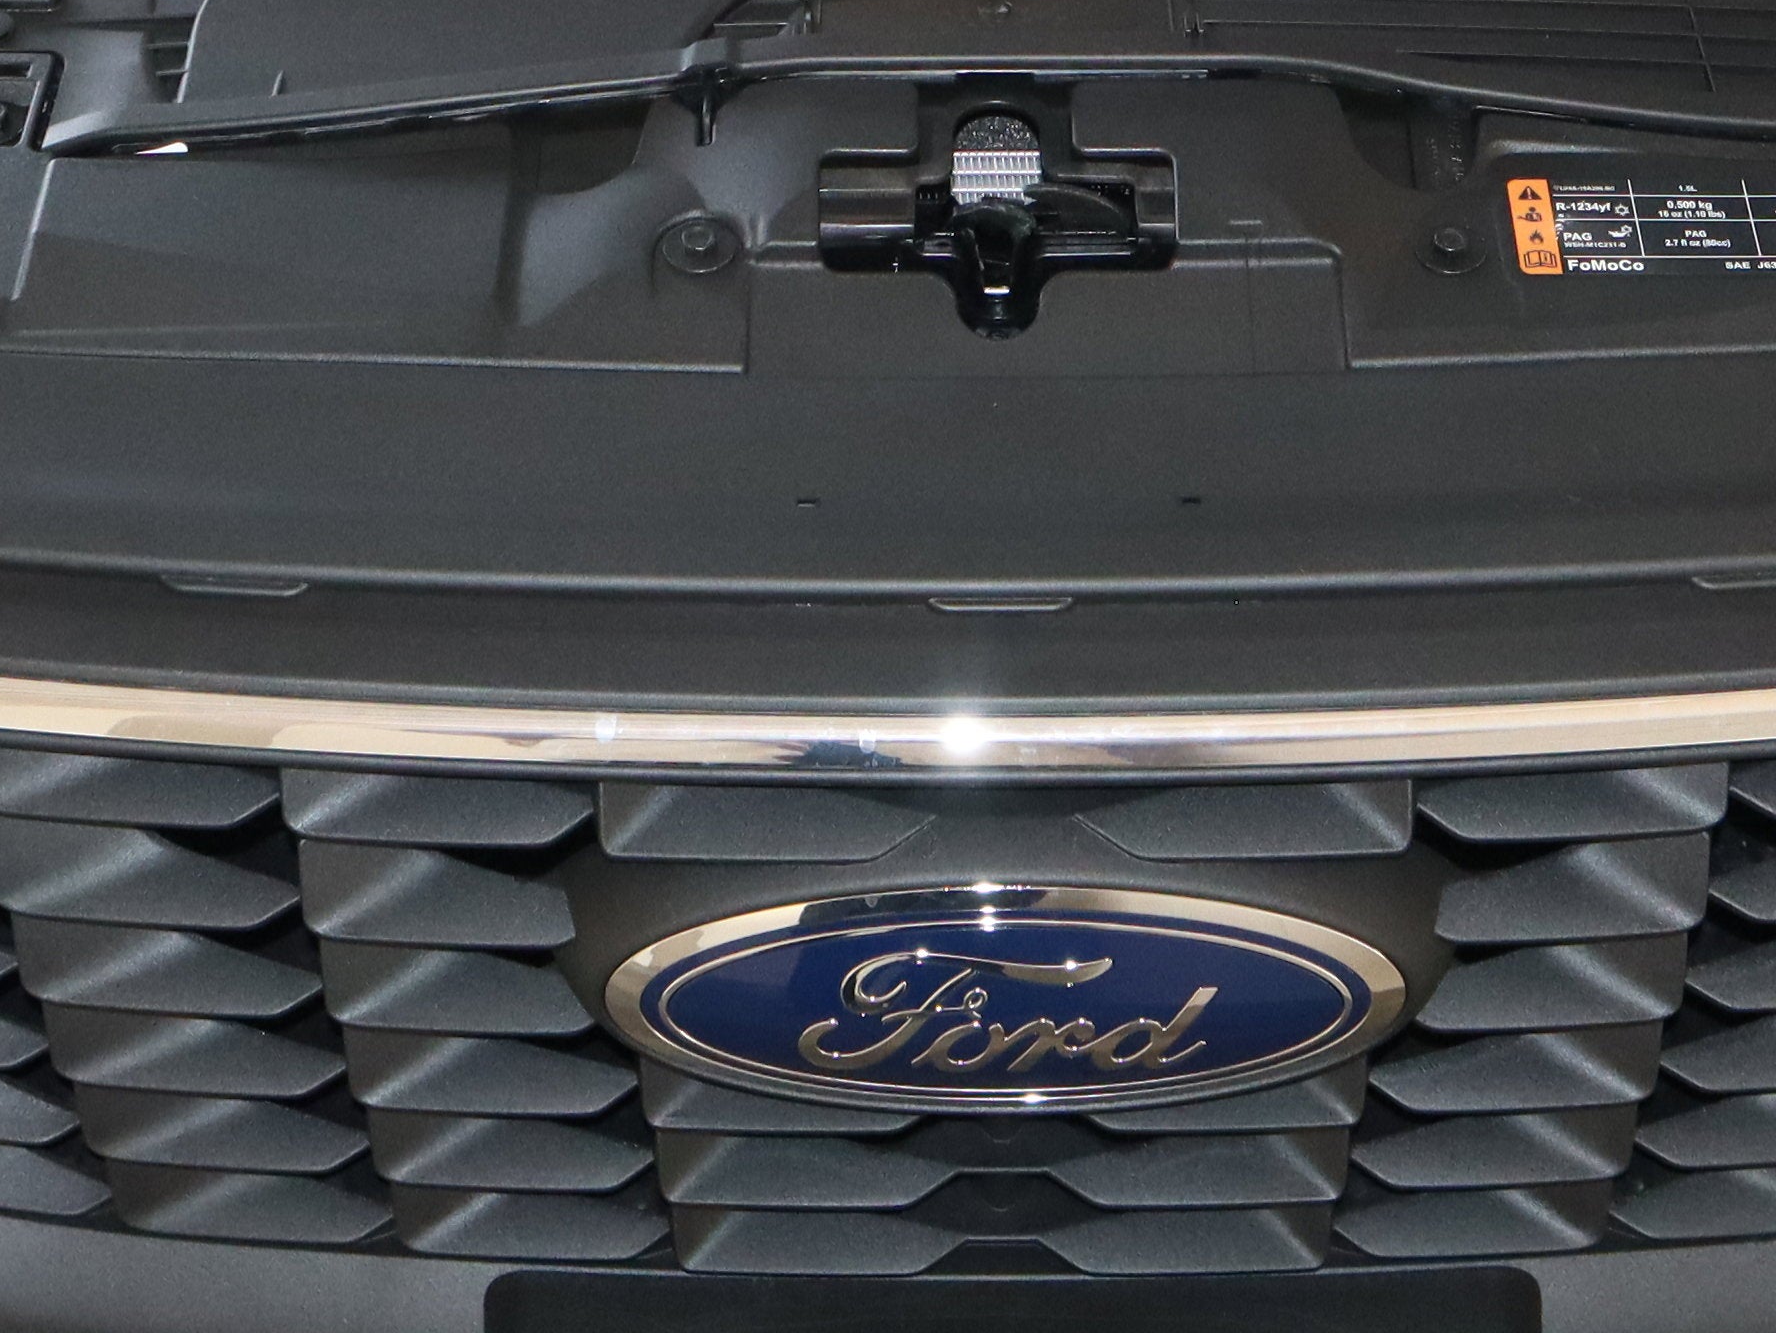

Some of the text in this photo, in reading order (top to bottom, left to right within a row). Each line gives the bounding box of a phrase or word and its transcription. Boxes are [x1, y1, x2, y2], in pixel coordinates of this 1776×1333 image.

[1555, 201, 1612, 213] R-1234yf
[1666, 200, 1713, 211] 0.500 kg
[1563, 232, 1593, 242] PAG
[1684, 230, 1707, 238] PAG
[1664, 239, 1679, 247] 2.7
[1567, 259, 1645, 272] FoMoCo
[797, 951, 1218, 1073] Ford
